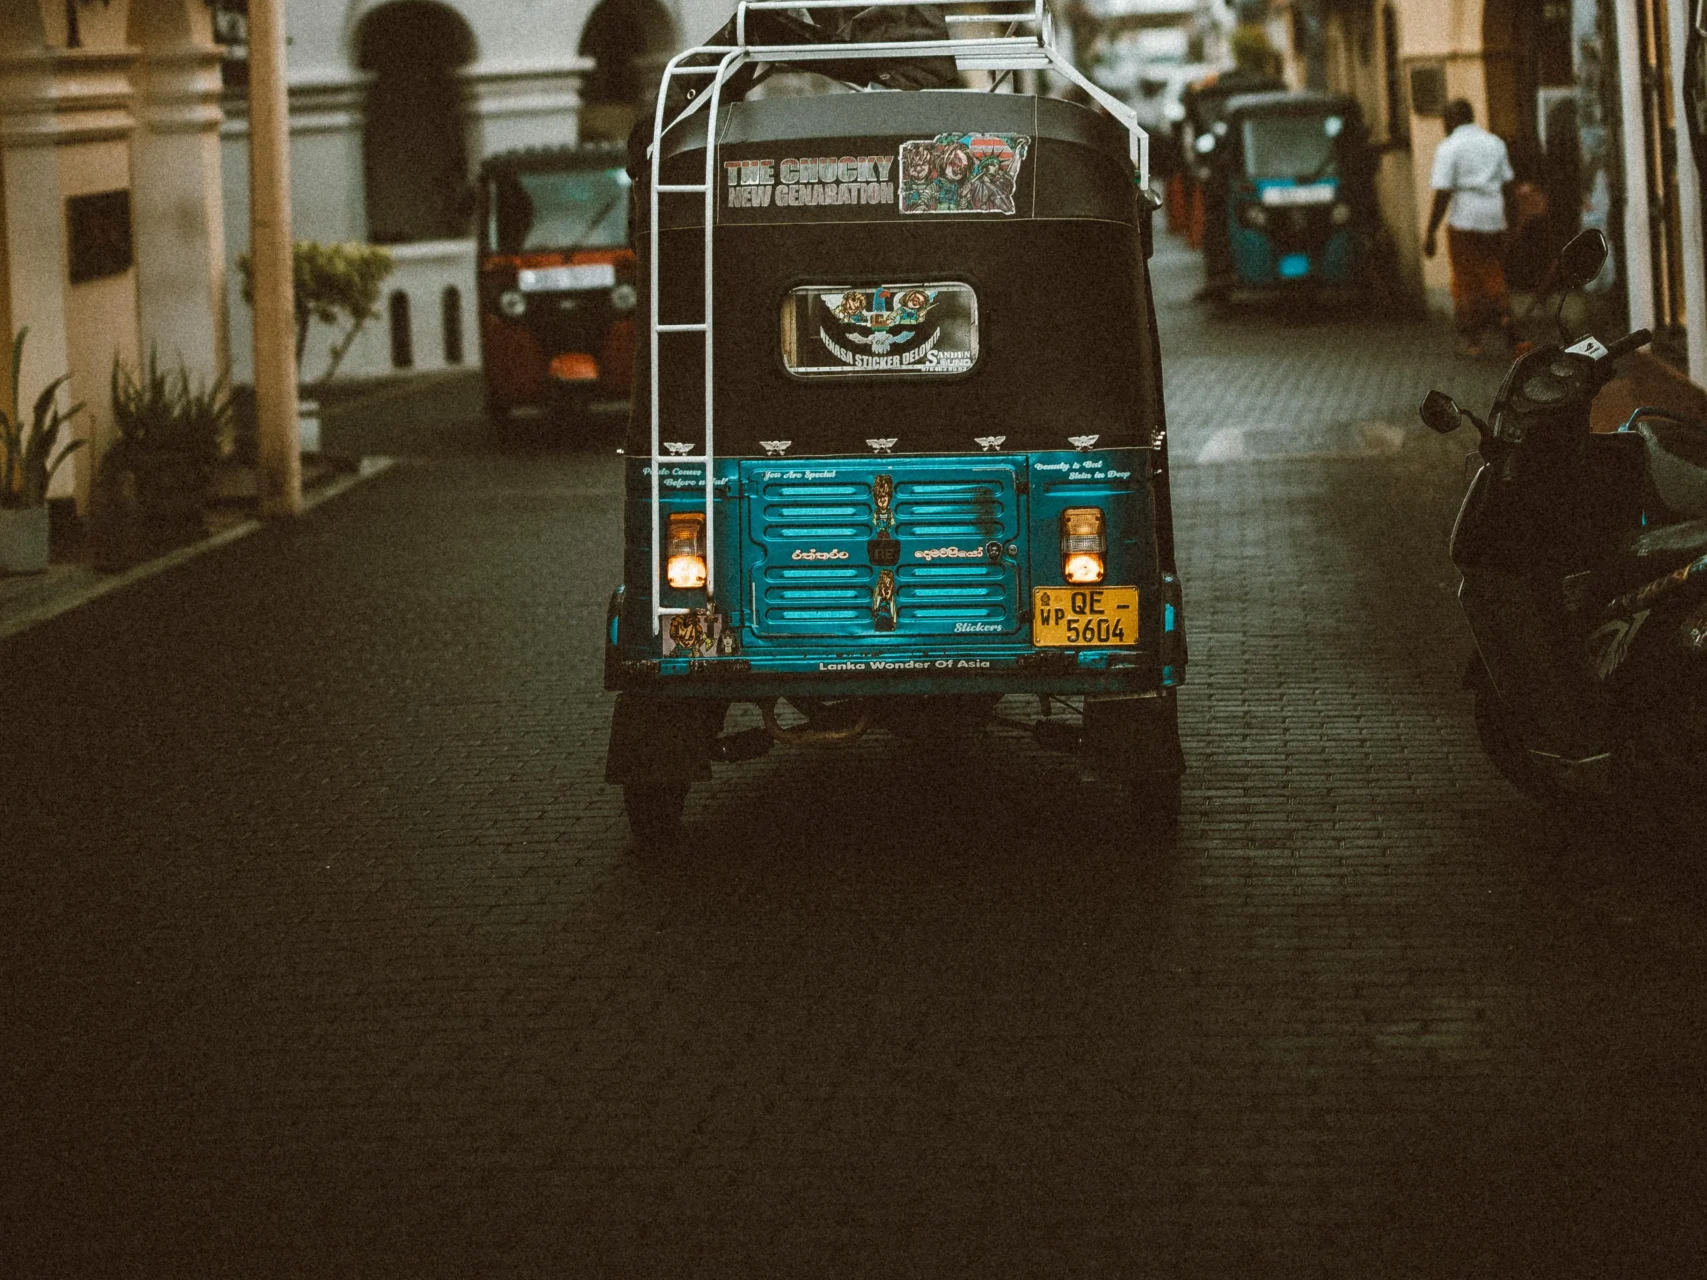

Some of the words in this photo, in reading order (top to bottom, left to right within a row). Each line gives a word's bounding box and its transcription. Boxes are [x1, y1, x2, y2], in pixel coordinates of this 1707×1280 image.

[724, 158, 775, 186] THE
[779, 155, 895, 184] CHUCKY
[728, 184, 774, 208] NEW
[775, 182, 894, 207] GENARATION
[855, 353, 901, 370] STICKER
[672, 467, 702, 476] Comes
[1034, 461, 1071, 472] Beauty
[1082, 460, 1103, 469] But
[763, 470, 782, 481] You
[783, 470, 803, 479] Are
[804, 470, 837, 481] Special
[1068, 471, 1092, 480] Skin
[1107, 470, 1131, 479] Deep
[664, 478, 696, 489] Before
[874, 548, 894, 560] RE
[1071, 590, 1105, 615] QE
[1040, 608, 1065, 626] WP
[954, 622, 1003, 633] Stickers
[1066, 618, 1125, 643] 5604
[819, 661, 866, 671] Lanka
[870, 660, 931, 670] Wonder
[935, 659, 954, 669] Of
[957, 659, 990, 669] Asia
